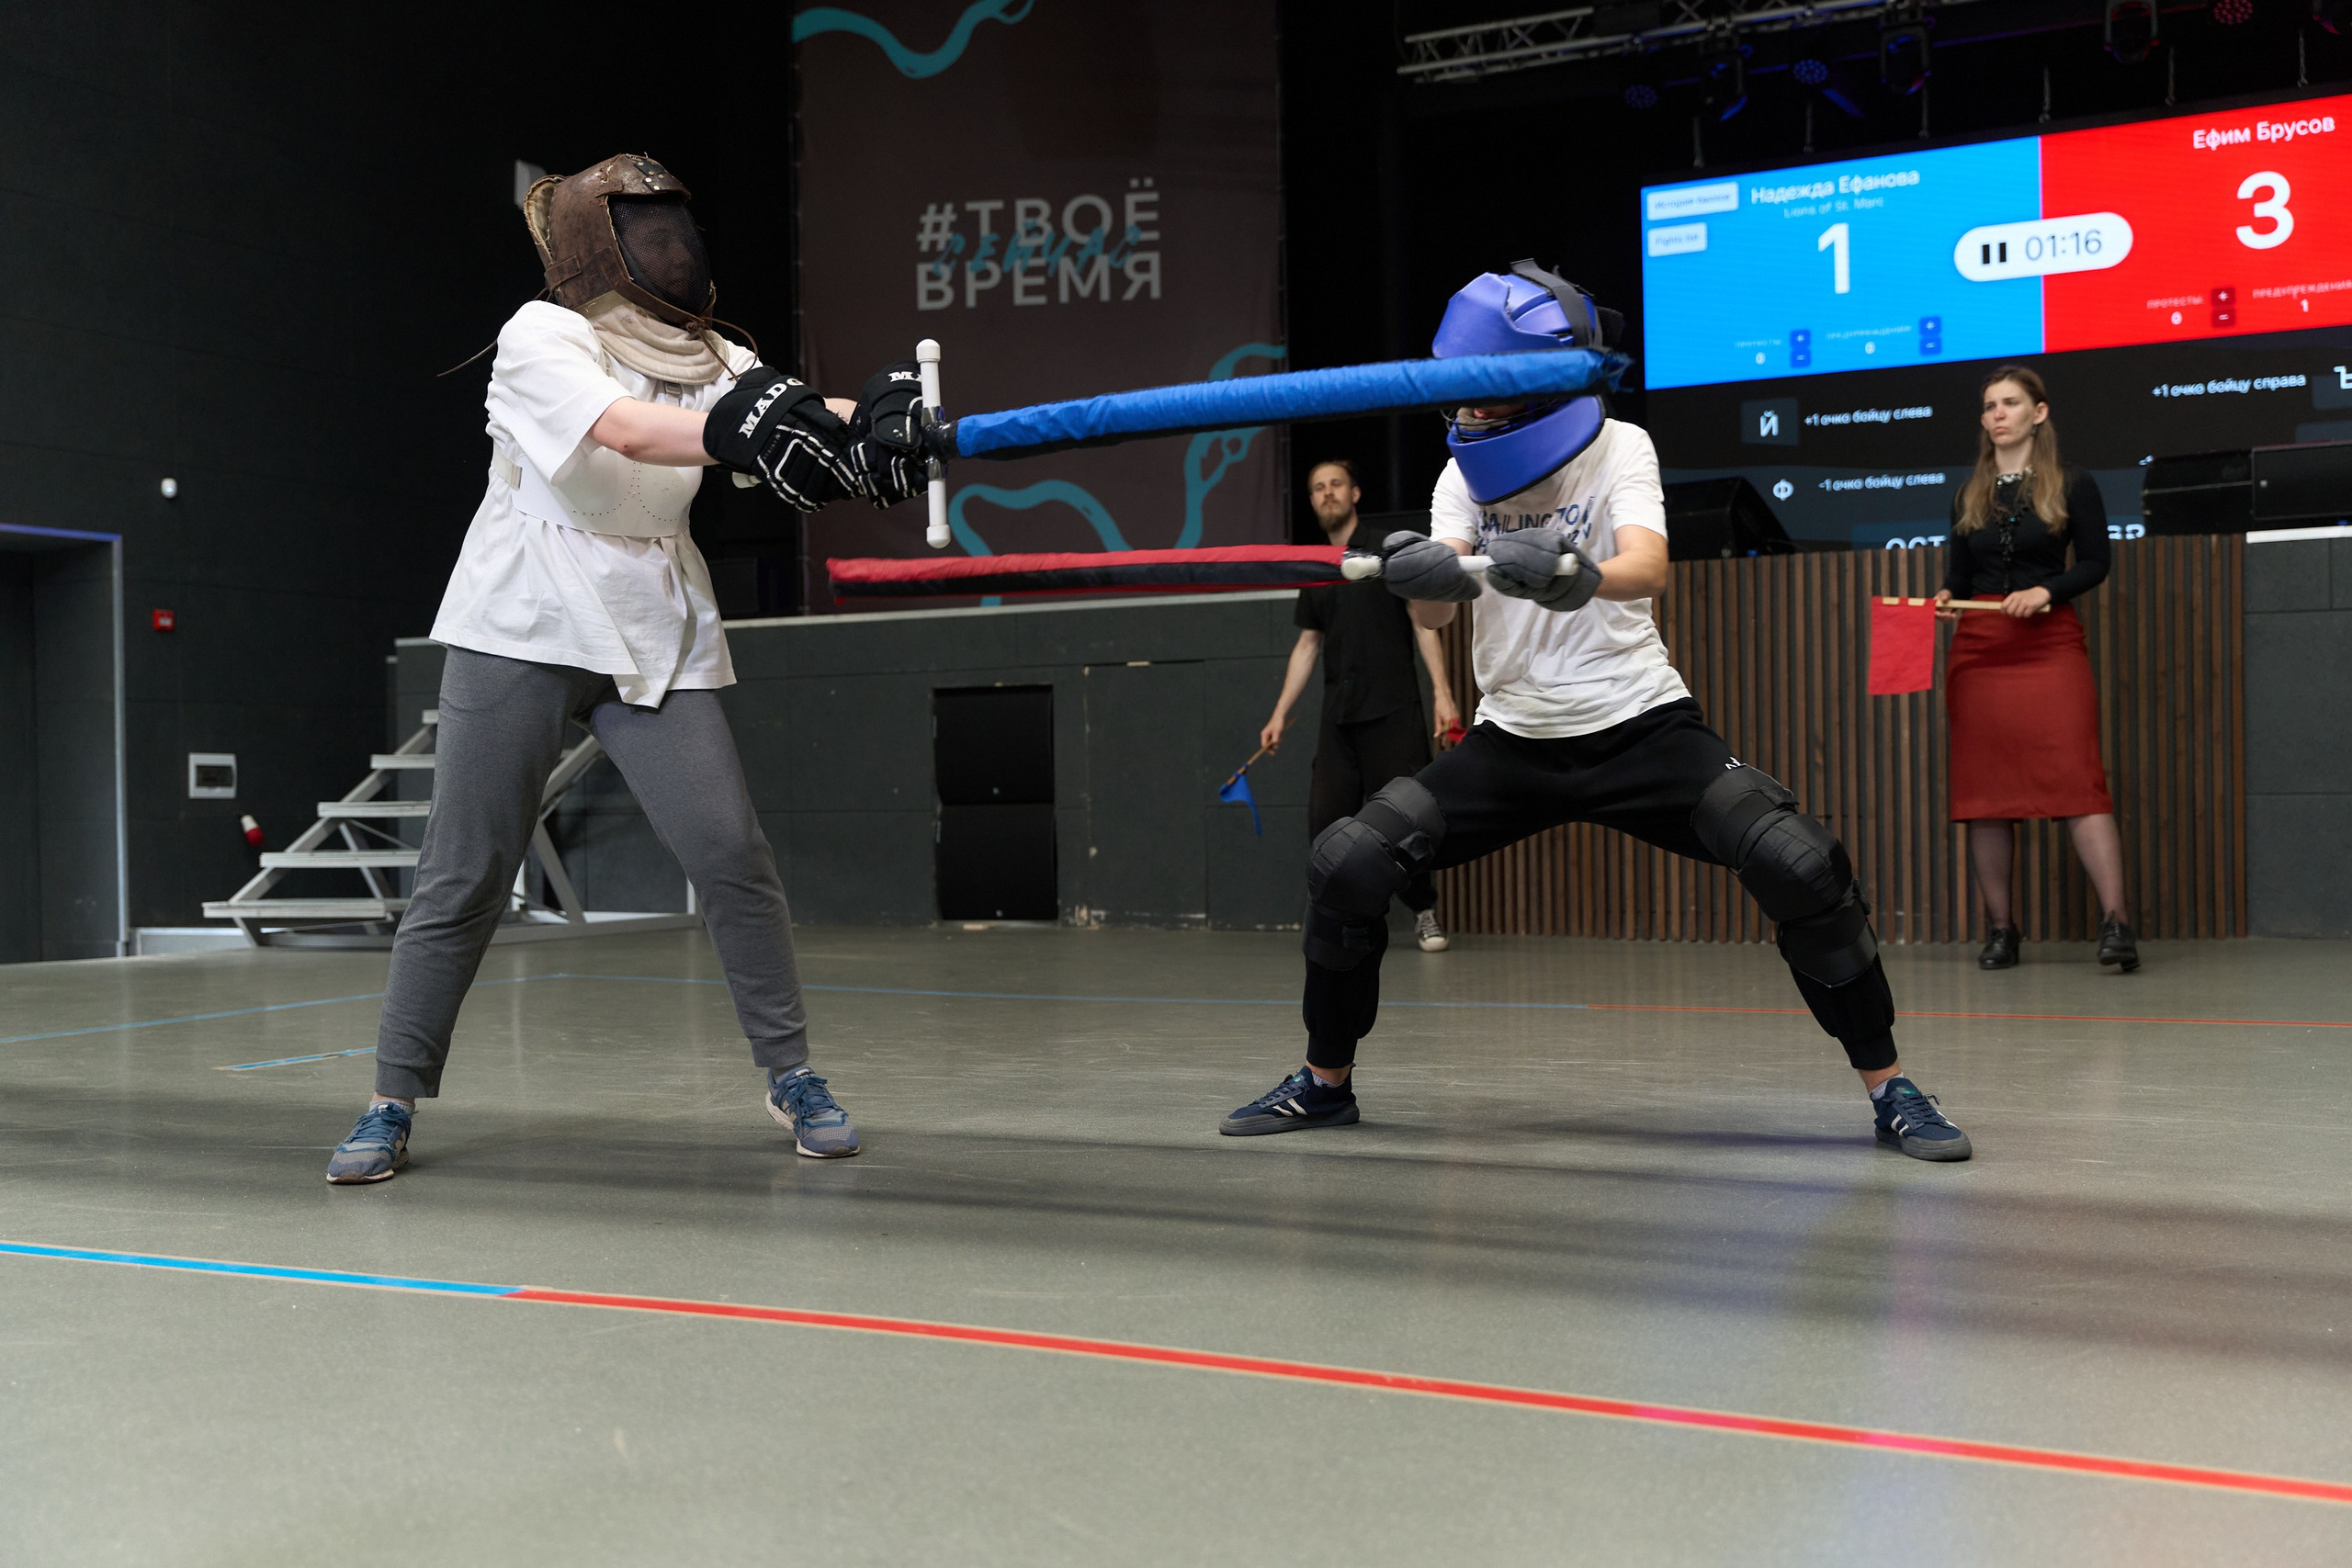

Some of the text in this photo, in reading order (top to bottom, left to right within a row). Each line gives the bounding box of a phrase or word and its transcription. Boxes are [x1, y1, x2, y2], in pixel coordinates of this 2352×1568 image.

[2192, 116, 2335, 151] Ефим Брусов
[1751, 169, 1920, 204] Надежда Ефанова
[917, 177, 1160, 253] #ТВОЁ
[2235, 171, 2294, 249] 3
[1817, 222, 1850, 294] 1
[2025, 230, 2103, 261] 01:16
[916, 251, 1161, 310] ВРЕМЯ
[2301, 299, 2309, 312] 1
[2152, 374, 2307, 398] +1 очко бойцу справа
[1759, 410, 1779, 437] Й
[1804, 405, 1933, 426] +1 очко бойцу слева
[1772, 478, 1794, 501] Ф
[1819, 472, 1946, 491] -1 очко бойцу слева
